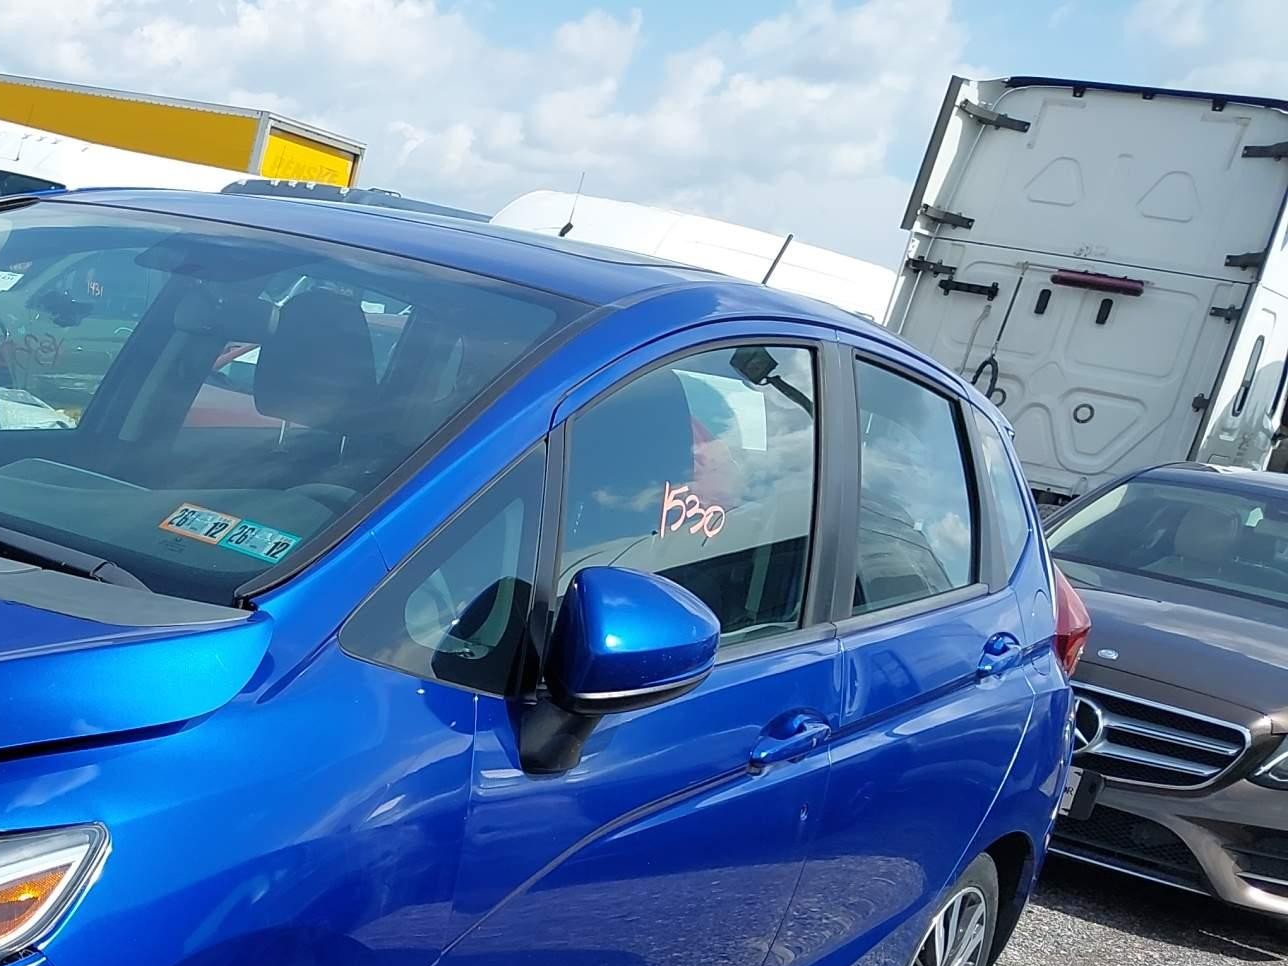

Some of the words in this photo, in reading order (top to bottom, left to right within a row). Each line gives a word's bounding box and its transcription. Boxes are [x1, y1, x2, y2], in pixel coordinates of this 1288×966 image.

[168, 507, 196, 528] 26
[203, 521, 229, 539] 12
[659, 480, 726, 539] 1530
[227, 524, 256, 545] 26
[263, 540, 290, 559] 12
